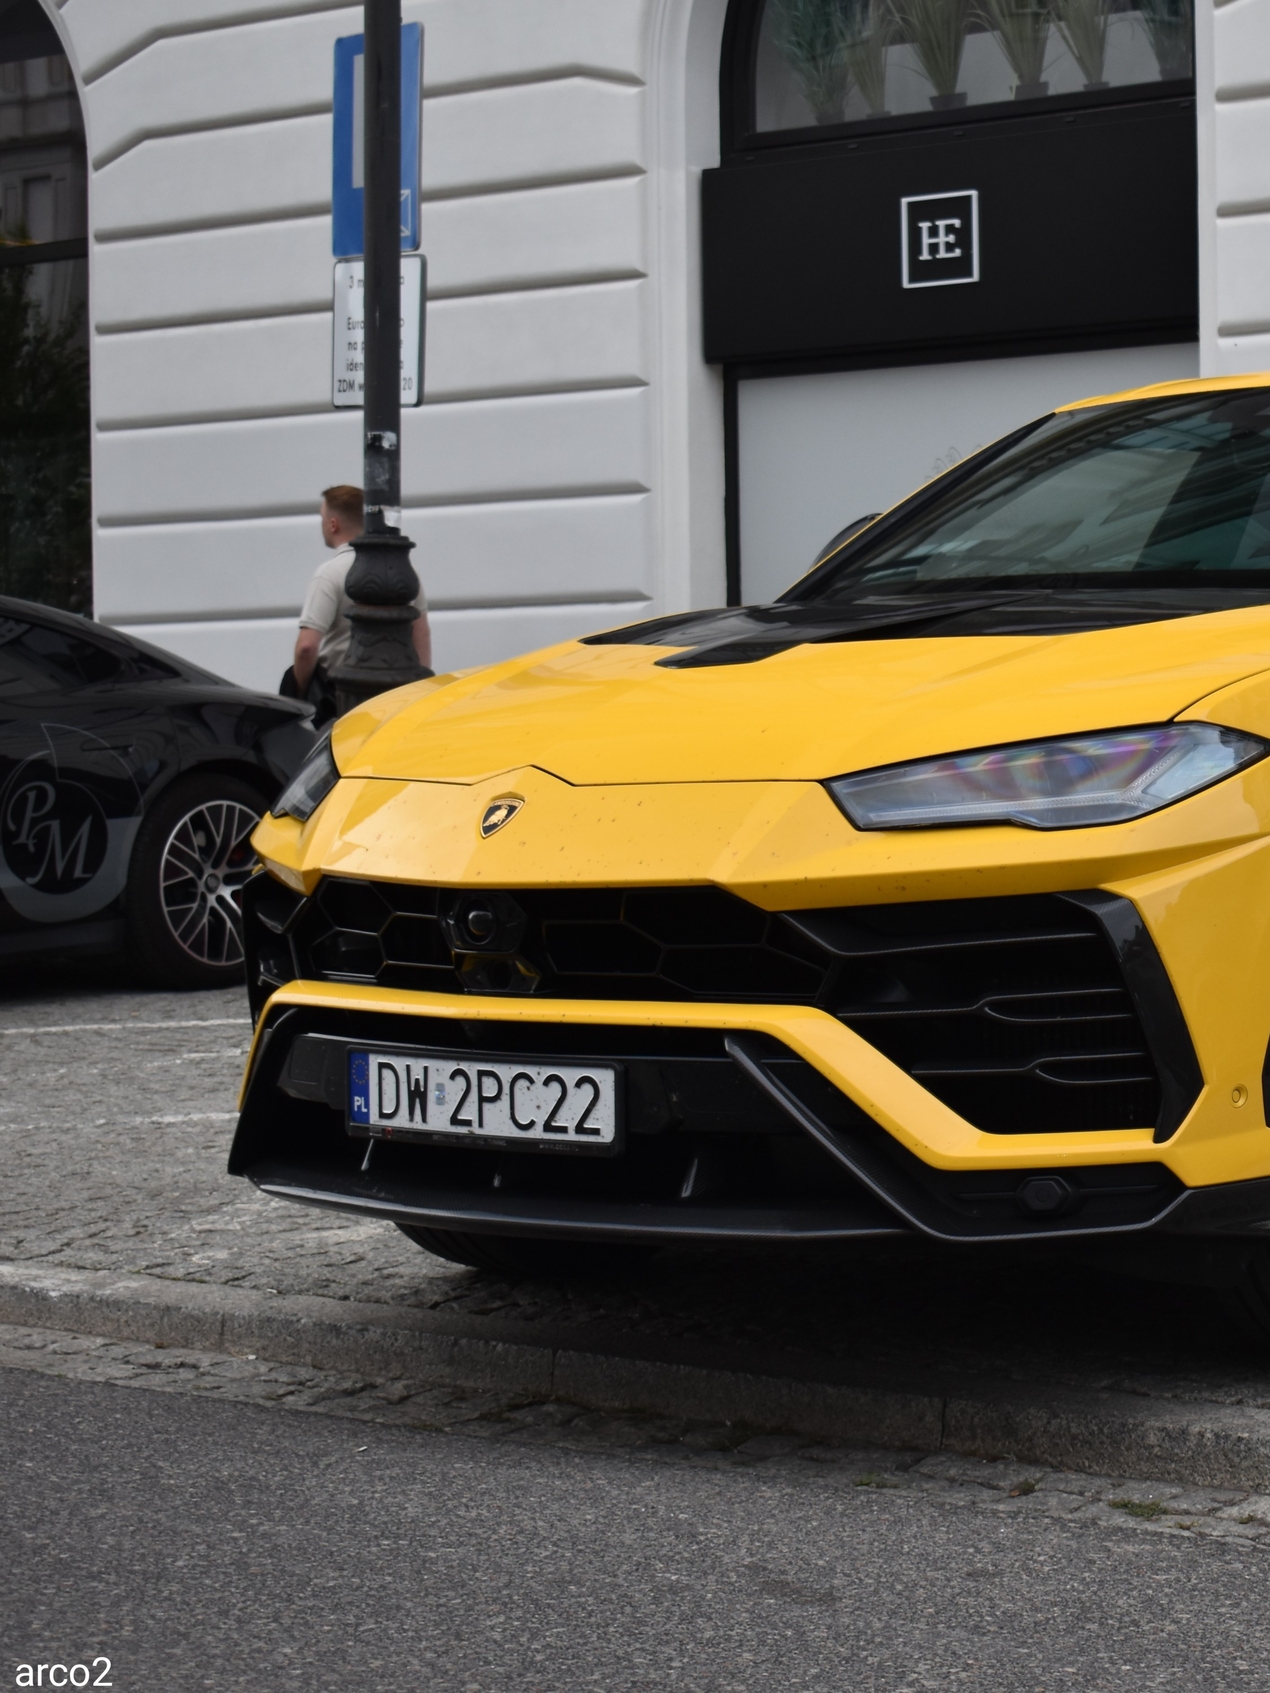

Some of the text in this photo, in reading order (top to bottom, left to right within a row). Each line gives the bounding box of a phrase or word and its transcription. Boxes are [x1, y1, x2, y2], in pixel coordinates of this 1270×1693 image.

[917, 218, 962, 261] HE
[349, 275, 354, 289] 3
[347, 341, 358, 351] na
[337, 380, 356, 393] ZDM
[354, 1095, 369, 1113] PL
[377, 1060, 602, 1137] DW 2PC22
